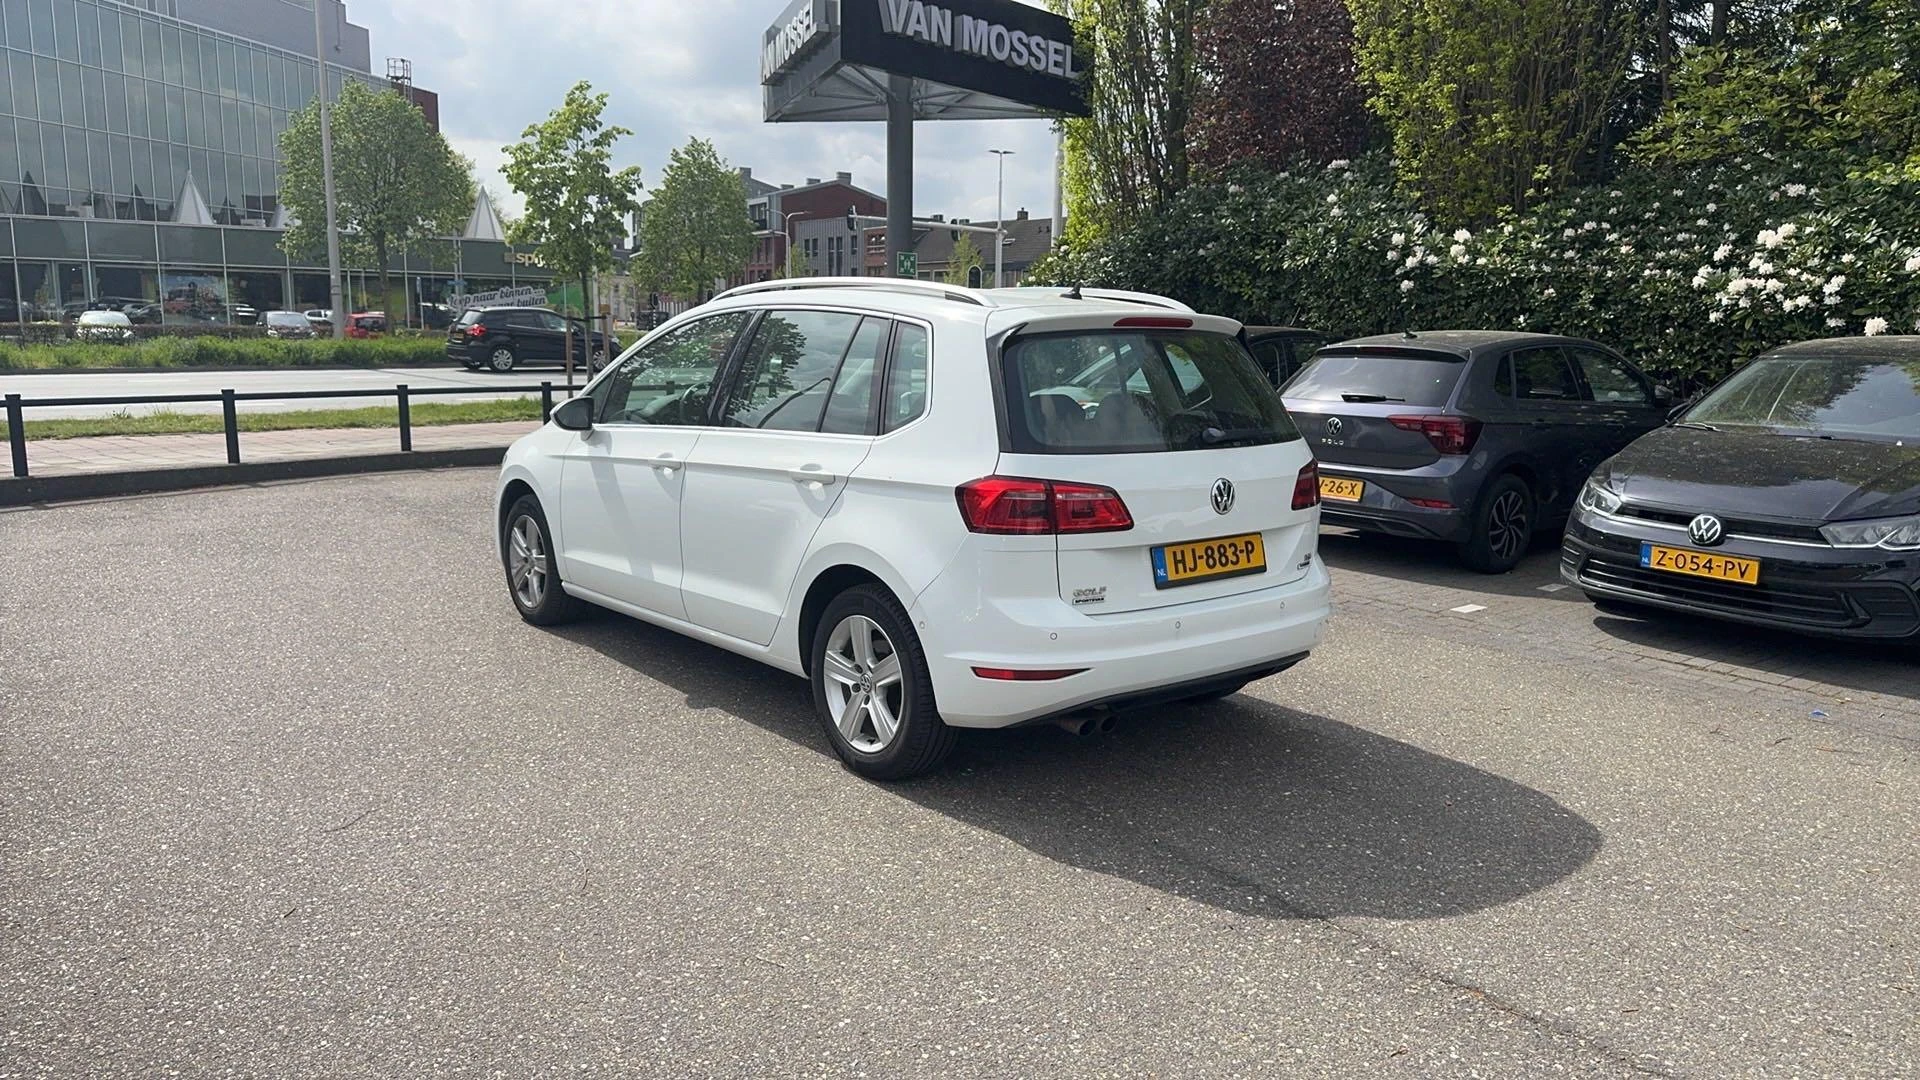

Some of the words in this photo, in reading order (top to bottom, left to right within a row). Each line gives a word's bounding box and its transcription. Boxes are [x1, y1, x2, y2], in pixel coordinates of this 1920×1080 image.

[880, 0, 951, 46] VAN
[956, 14, 1080, 79] MOSSEL
[473, 292, 497, 303] naar
[500, 287, 532, 299] binnen
[517, 297, 545, 307] buiten
[1321, 438, 1344, 446] POLO
[1157, 569, 1167, 577] NL
[1172, 540, 1255, 575] HJ-883-P
[1656, 550, 1750, 578] Z-054-PV
